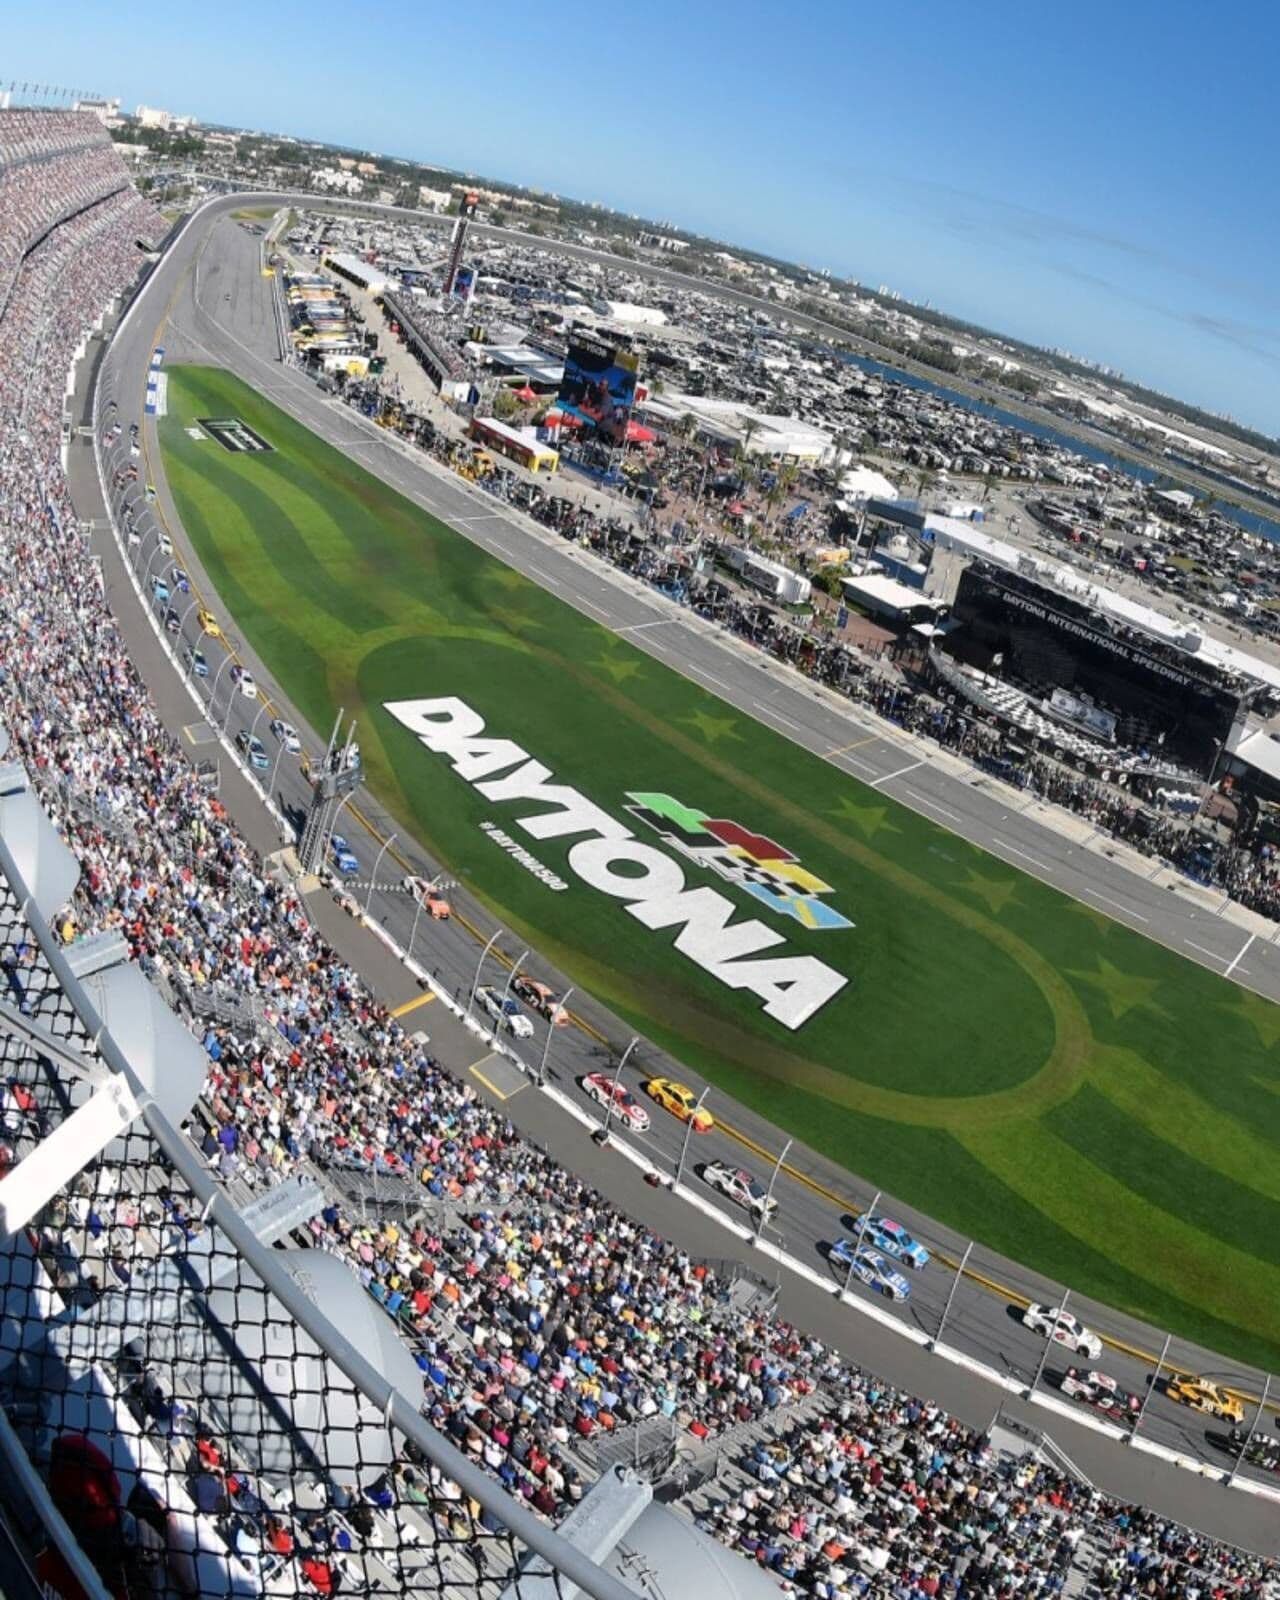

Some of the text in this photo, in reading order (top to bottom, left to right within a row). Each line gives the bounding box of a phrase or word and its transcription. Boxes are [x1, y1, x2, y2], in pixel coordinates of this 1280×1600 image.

[1002, 592, 1192, 686] DAYTONA INTERNATIONAL SPEEDWAY
[382, 696, 850, 1031] DAYTONA
[478, 821, 569, 891] #DAYTONA500
